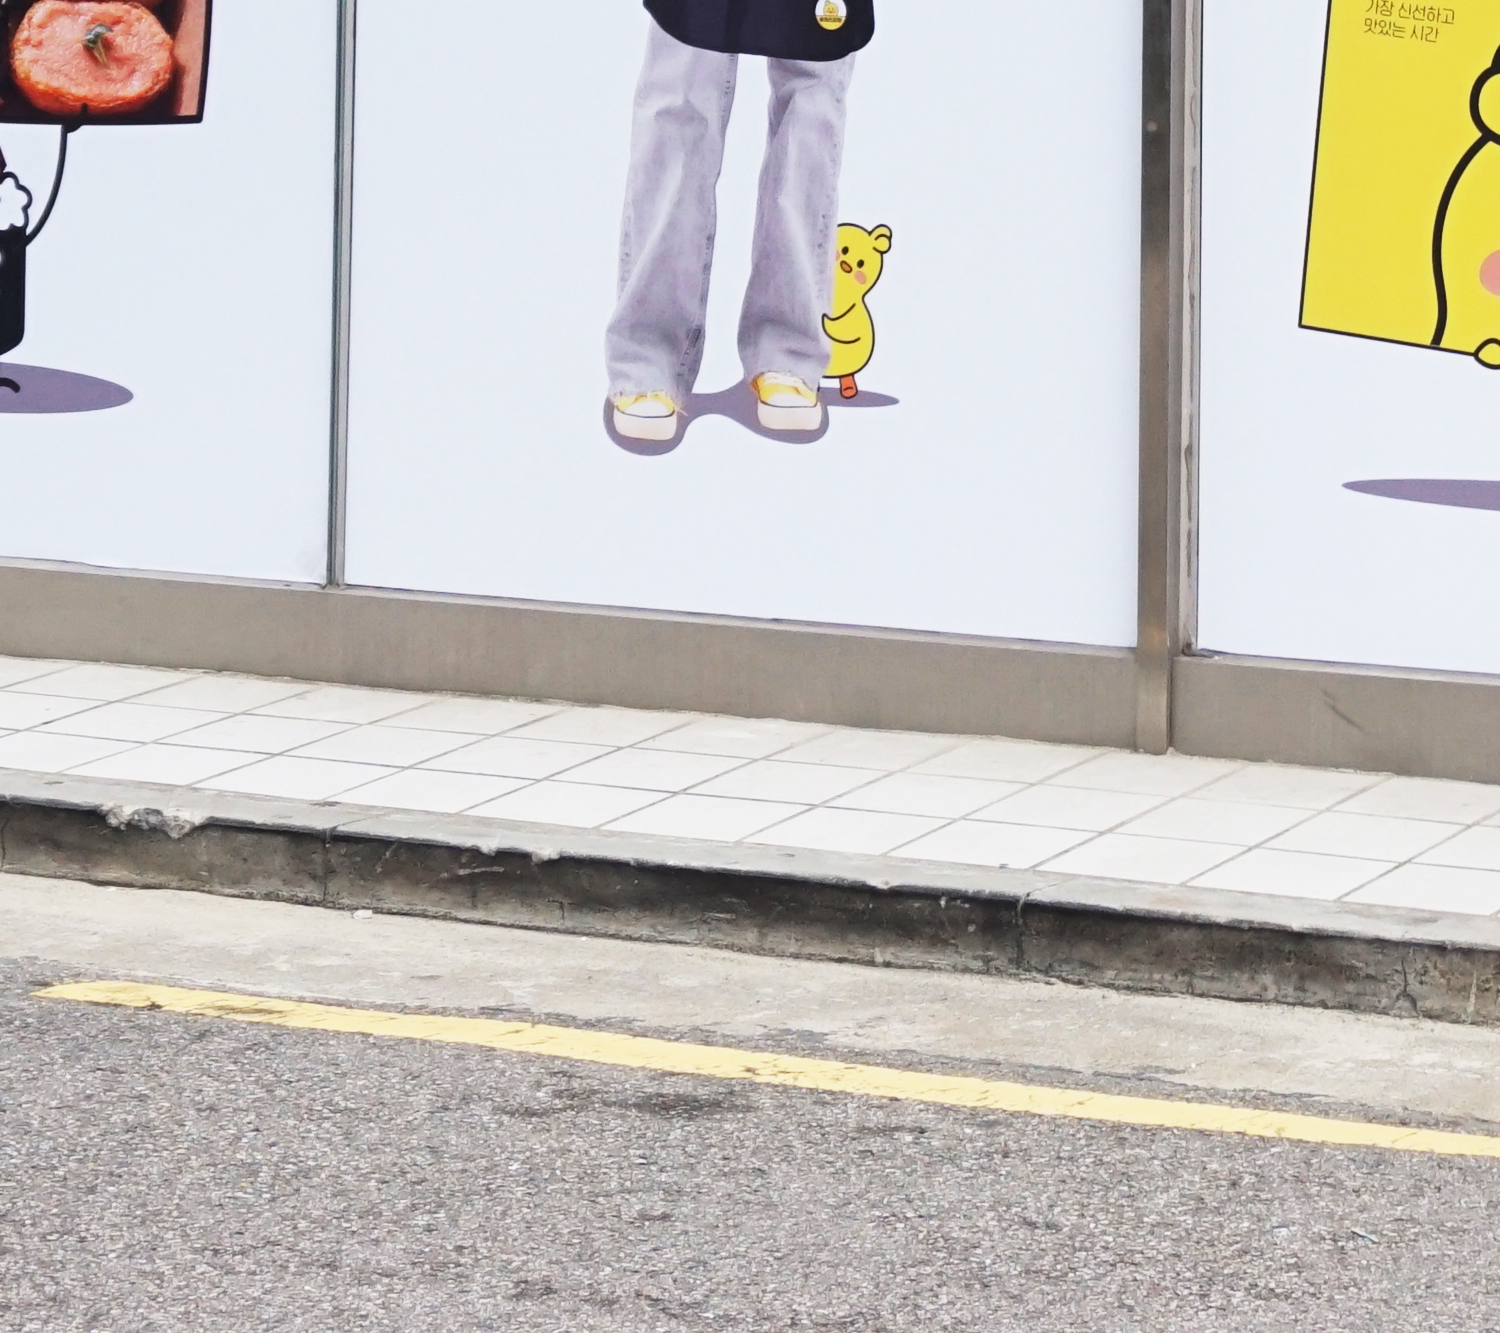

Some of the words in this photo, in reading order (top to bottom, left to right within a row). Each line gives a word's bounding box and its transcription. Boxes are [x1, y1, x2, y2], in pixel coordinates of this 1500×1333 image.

[1397, 1, 1456, 26] 신선하고
[1363, 17, 1407, 40] 맛있는
[1409, 24, 1440, 44] 시간
